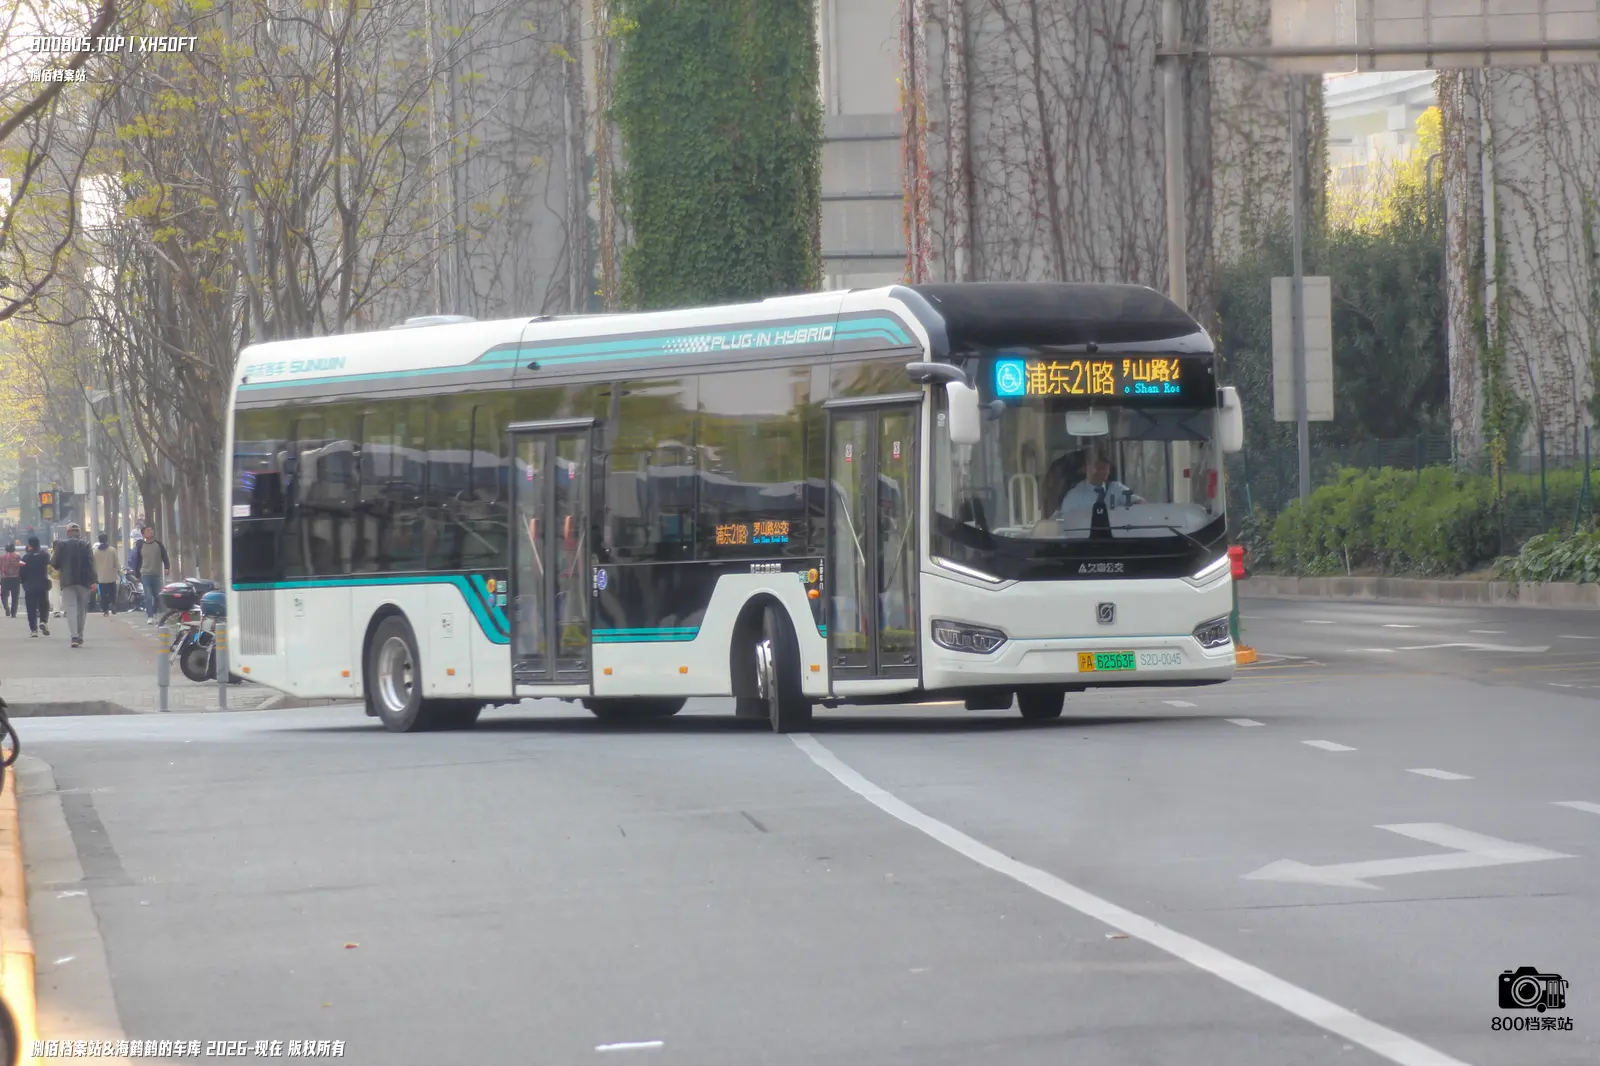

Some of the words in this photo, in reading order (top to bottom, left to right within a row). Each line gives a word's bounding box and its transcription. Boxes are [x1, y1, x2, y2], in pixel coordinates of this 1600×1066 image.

[775, 326, 833, 345] HYBRID
[290, 356, 346, 373] SUNWIN
[1025, 360, 1114, 395] 浦东21路
[1135, 383, 1159, 393] Shan
